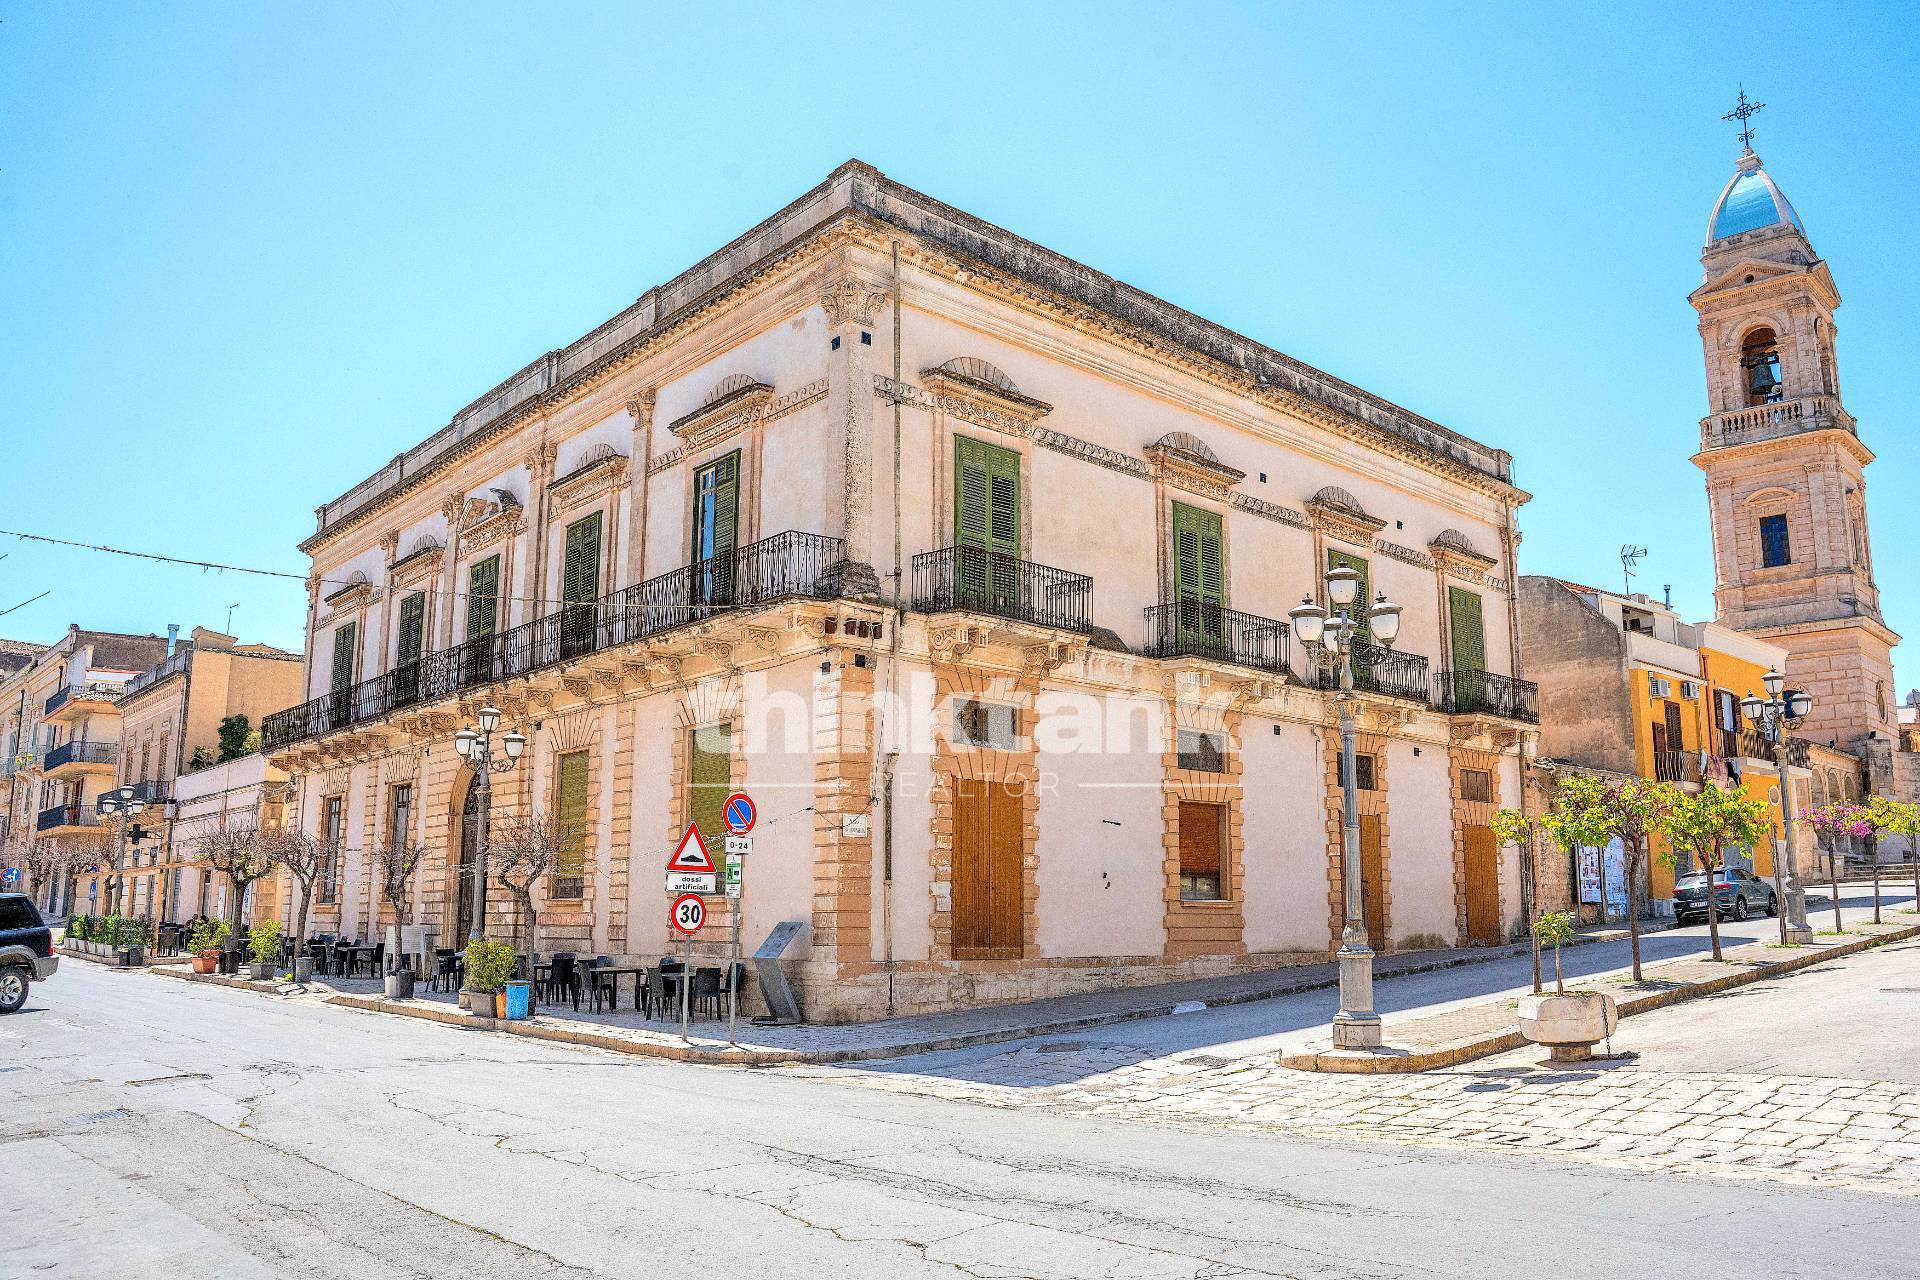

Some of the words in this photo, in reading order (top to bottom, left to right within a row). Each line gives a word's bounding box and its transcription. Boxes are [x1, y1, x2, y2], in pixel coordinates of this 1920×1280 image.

[729, 841, 748, 850] 0-24
[674, 883, 708, 891] artificiali
[679, 904, 700, 923] 30
